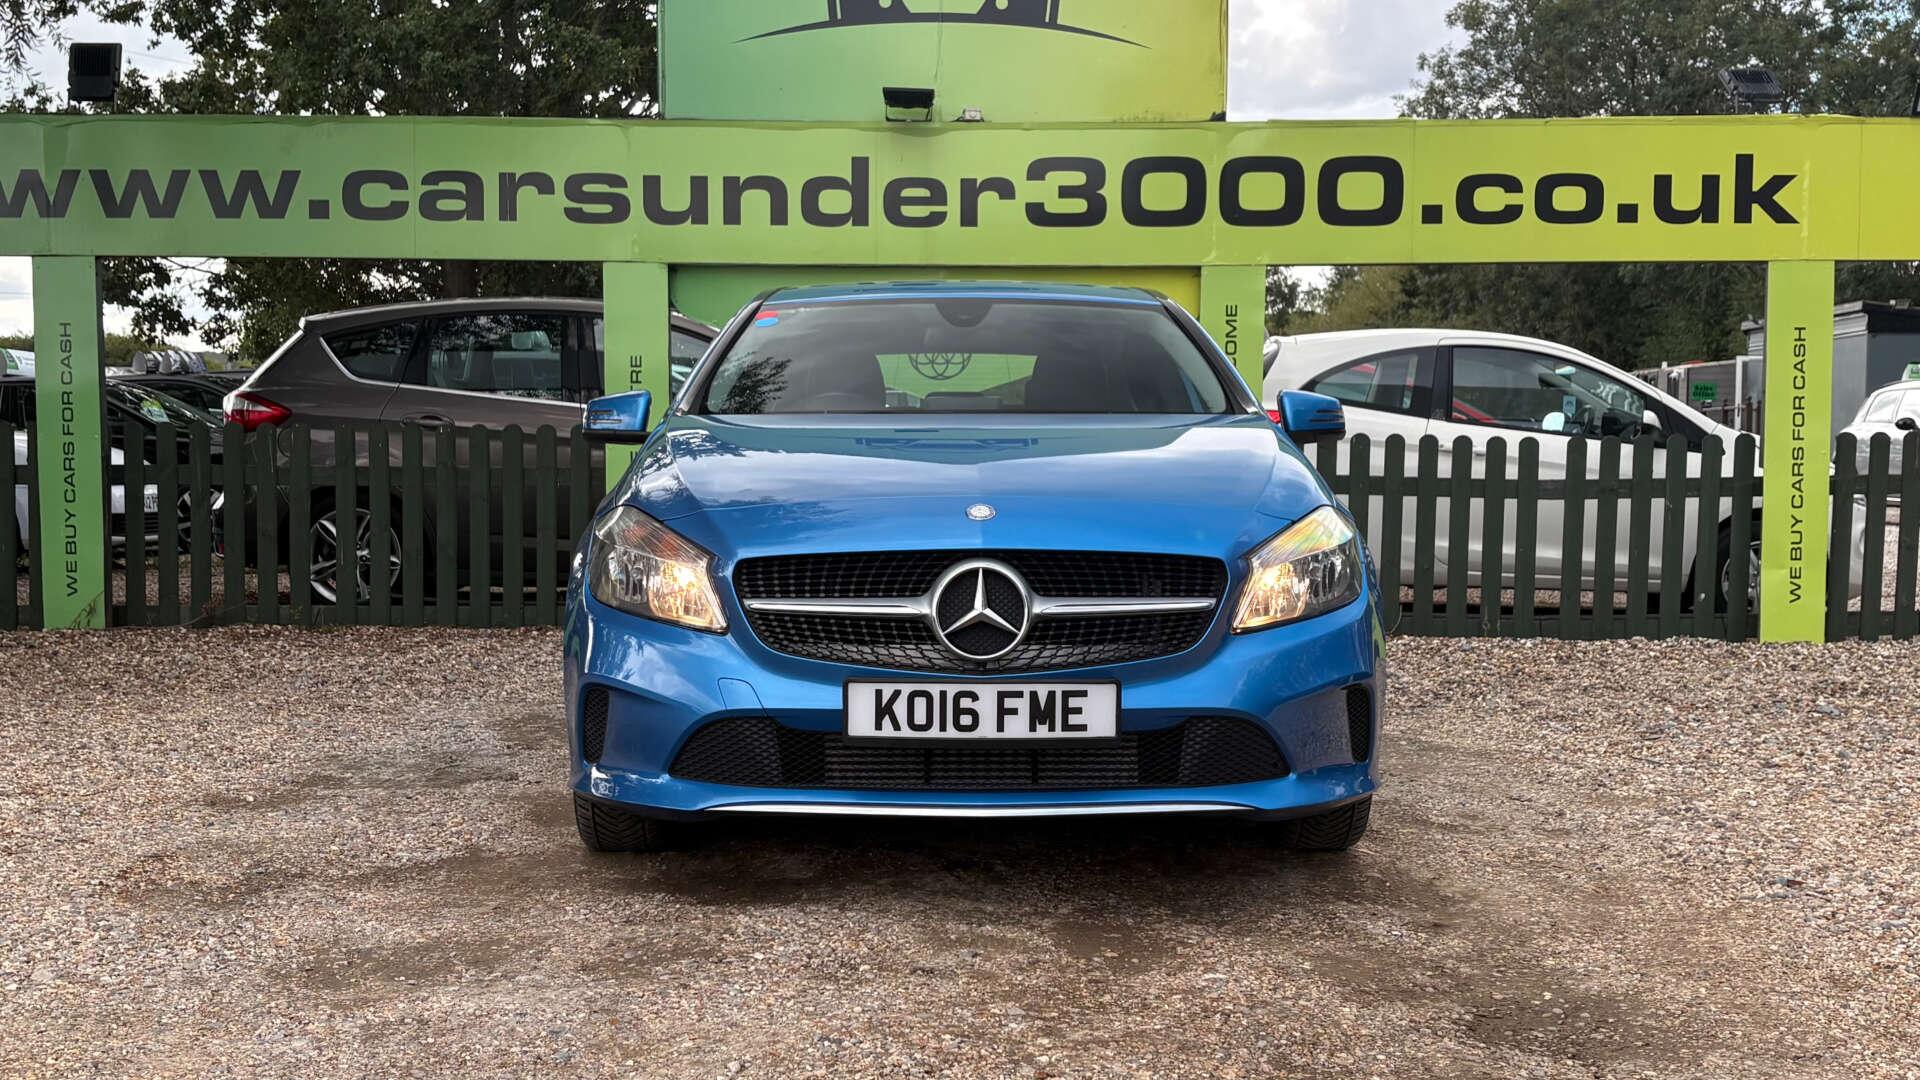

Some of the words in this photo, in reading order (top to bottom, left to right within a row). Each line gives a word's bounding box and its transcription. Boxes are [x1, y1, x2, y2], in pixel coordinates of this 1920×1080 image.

[0, 154, 1799, 227] www.carsunder3000.co.uk
[59, 322, 73, 385] CASH
[630, 355, 642, 391] RE
[1793, 326, 1807, 390] CASH
[61, 390, 74, 436] FOR
[1792, 395, 1805, 441] FOR
[63, 441, 76, 503] CARS
[1791, 446, 1805, 509] CARS
[64, 508, 77, 555] BUY
[1790, 514, 1803, 561] BUY
[65, 559, 78, 597] WE
[1789, 566, 1802, 604] WE
[874, 689, 980, 733] KO16
[996, 690, 1089, 733] FME
